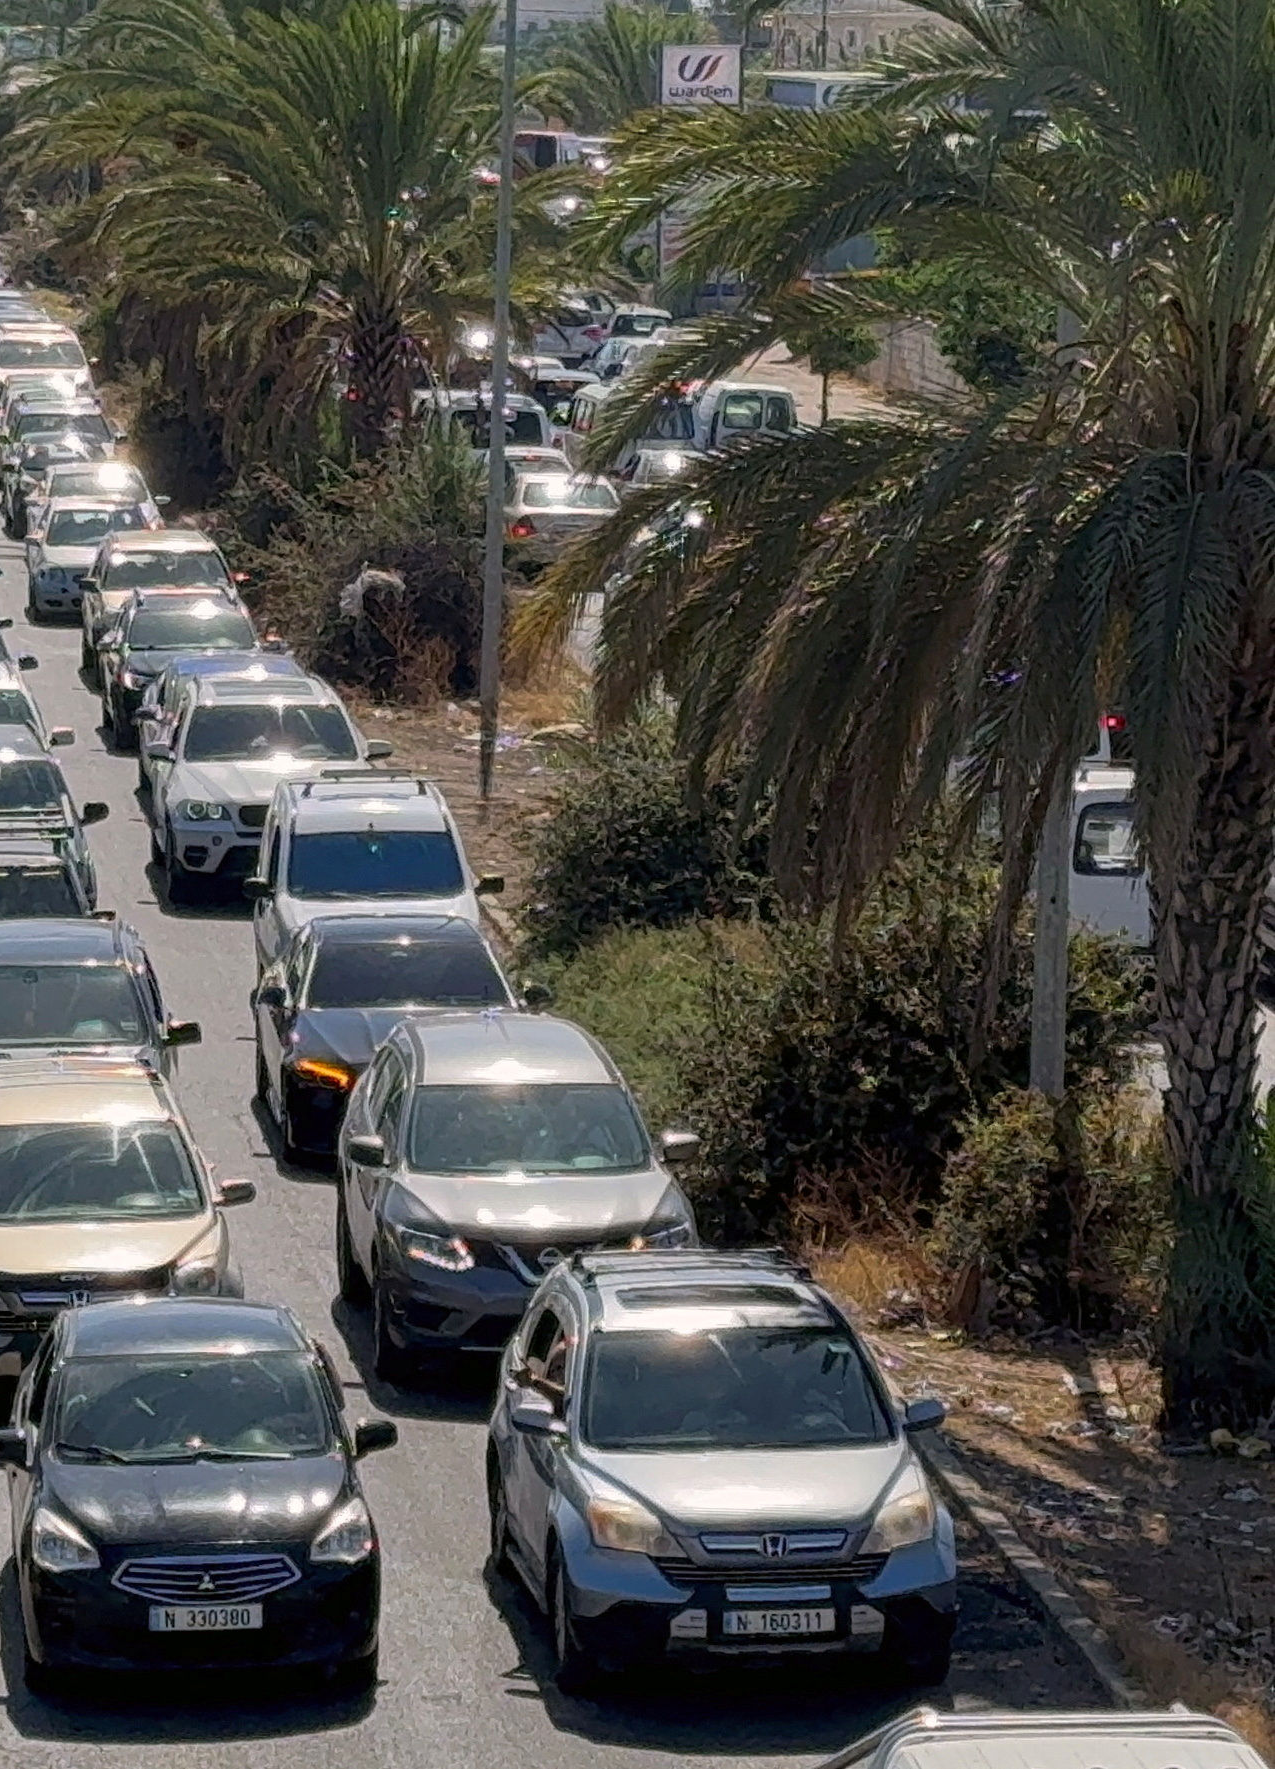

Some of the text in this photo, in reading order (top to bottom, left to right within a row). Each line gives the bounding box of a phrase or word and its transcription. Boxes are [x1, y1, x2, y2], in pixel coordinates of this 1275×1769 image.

[164, 1608, 251, 1628] N 330380
[736, 1611, 822, 1632] N 160311
